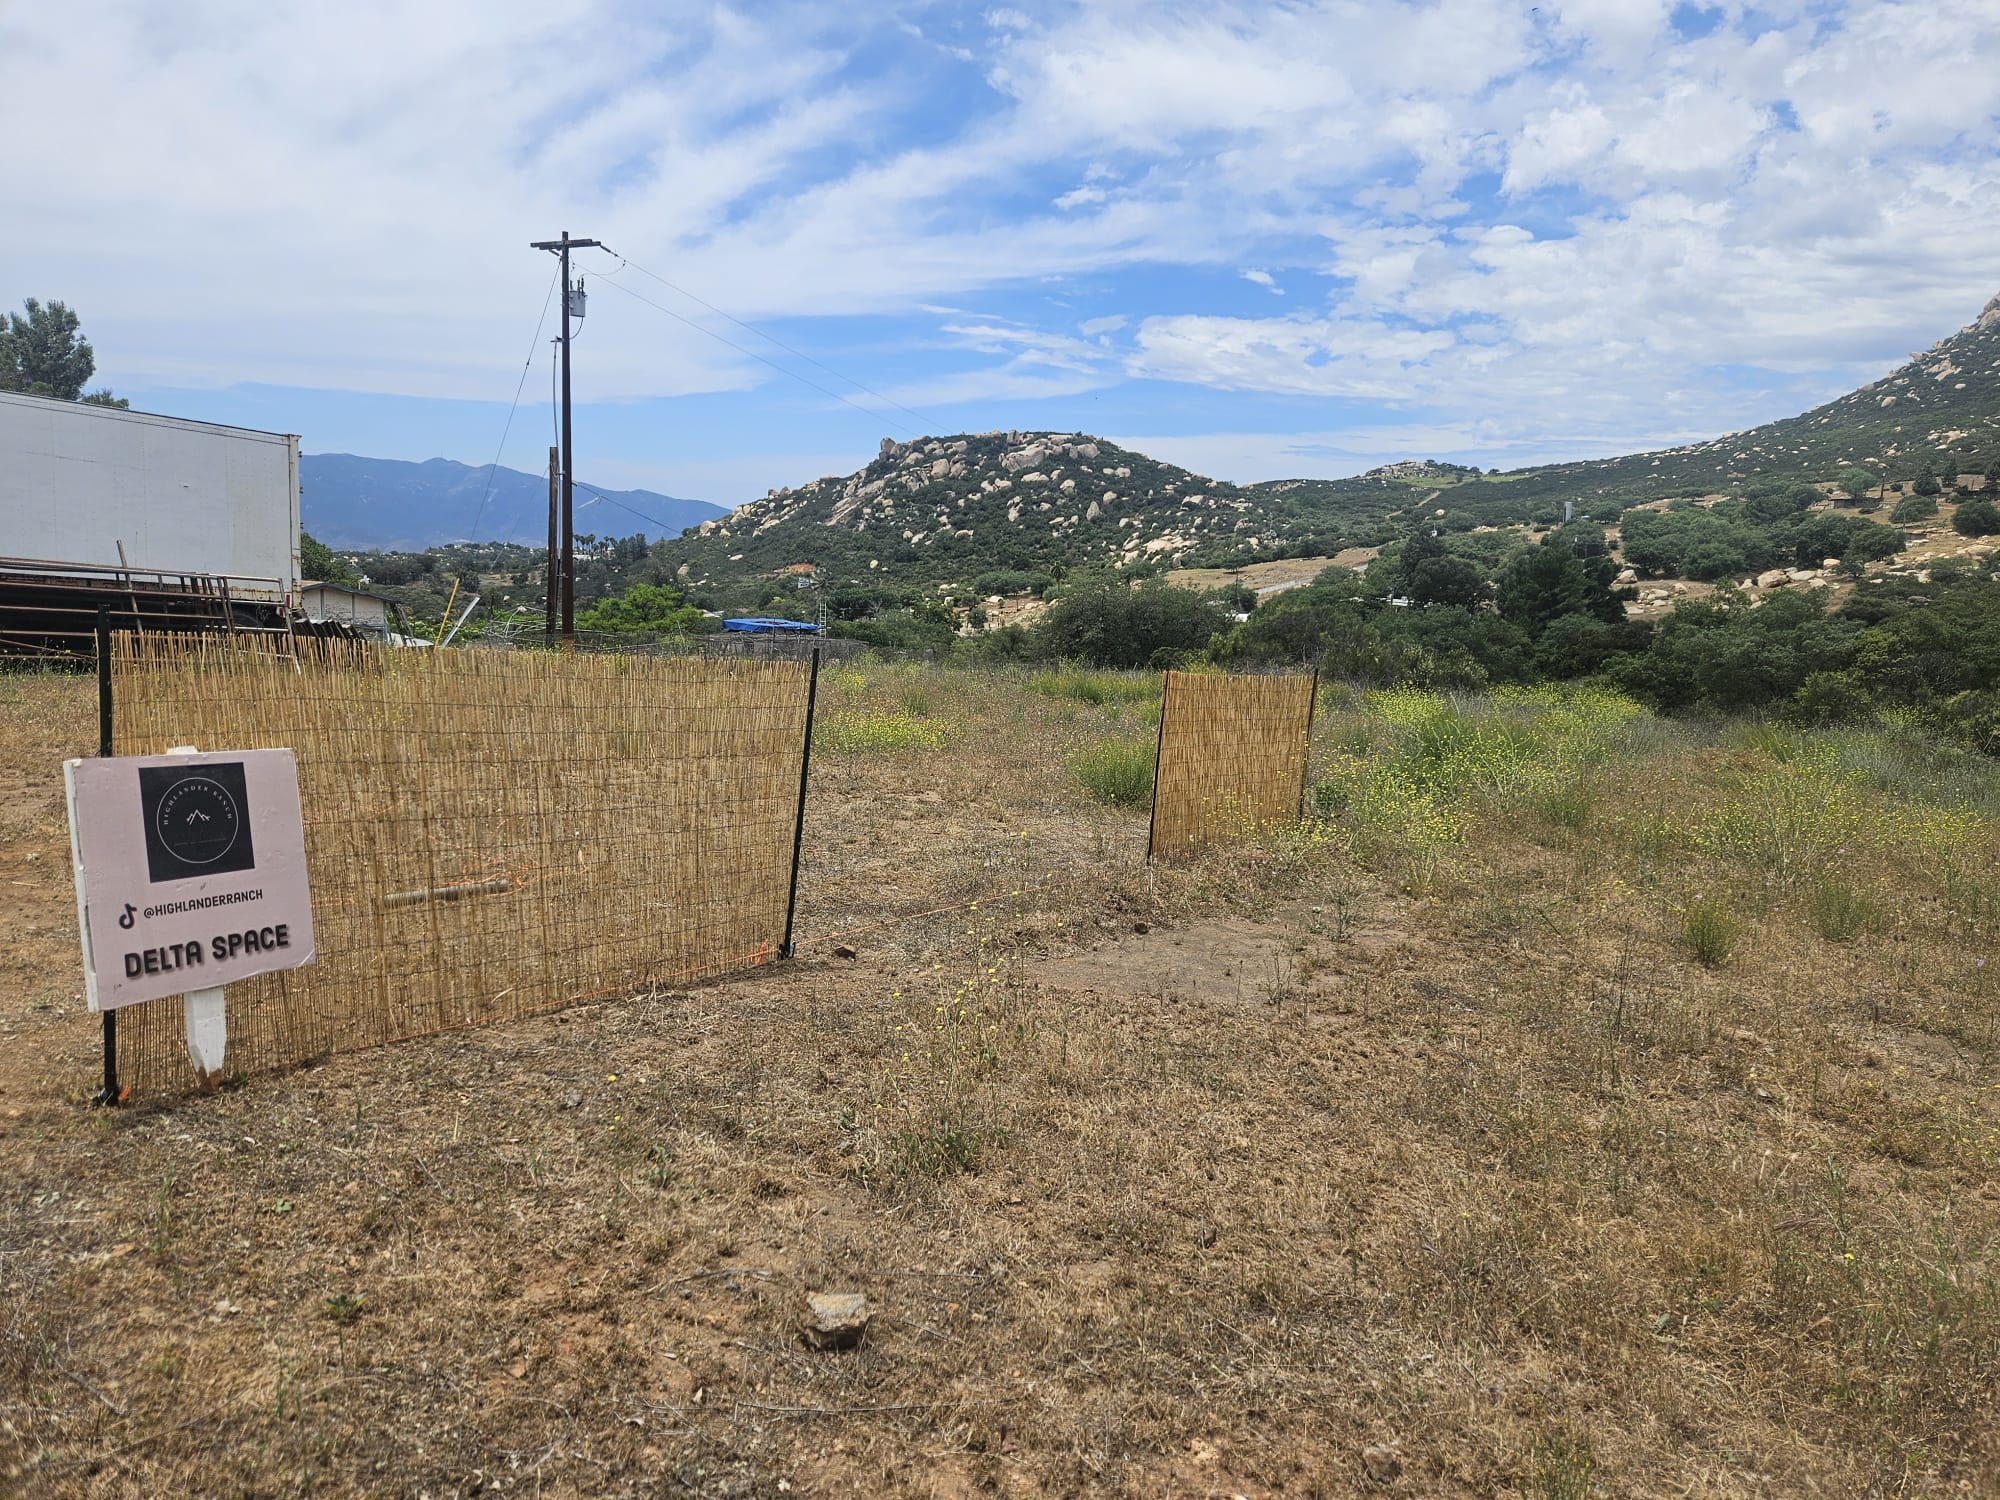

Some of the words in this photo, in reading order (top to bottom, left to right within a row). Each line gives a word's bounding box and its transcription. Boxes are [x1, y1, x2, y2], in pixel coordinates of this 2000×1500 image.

[163, 785, 209, 825] HIGHLANDER
[212, 790, 233, 819] RANCH
[143, 889, 263, 919] @HIGHLANDERRANCH
[124, 940, 203, 978] DELTA
[211, 924, 289, 960] SPACE
